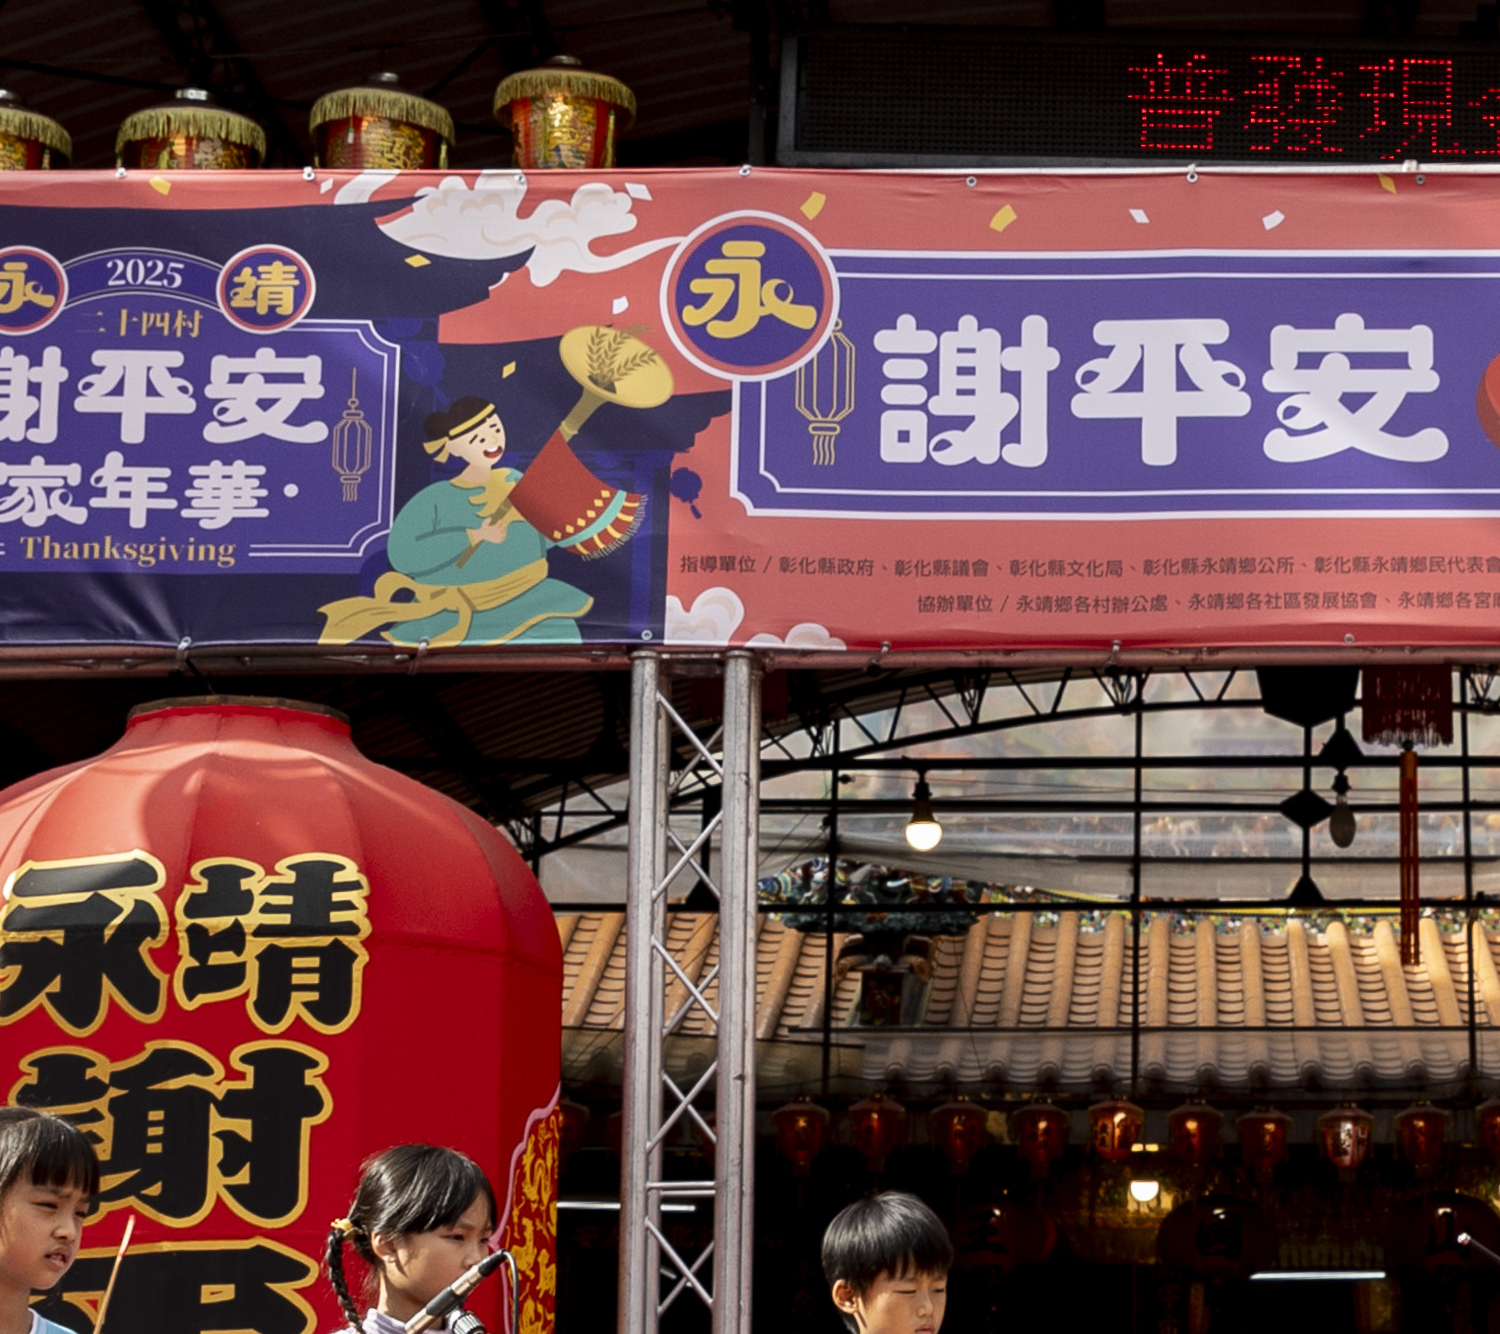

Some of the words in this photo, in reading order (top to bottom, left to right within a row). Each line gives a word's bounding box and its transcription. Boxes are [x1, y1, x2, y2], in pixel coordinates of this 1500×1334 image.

[106, 258, 184, 289] 2025
[230, 260, 301, 316] 靖
[682, 239, 818, 341] 永
[76, 308, 205, 339] 二十四村
[873, 312, 1450, 468] 謝平安
[19, 535, 237, 568] Thanksgiving
[680, 555, 757, 575] 指導單位
[917, 594, 994, 614] 協辦單位
